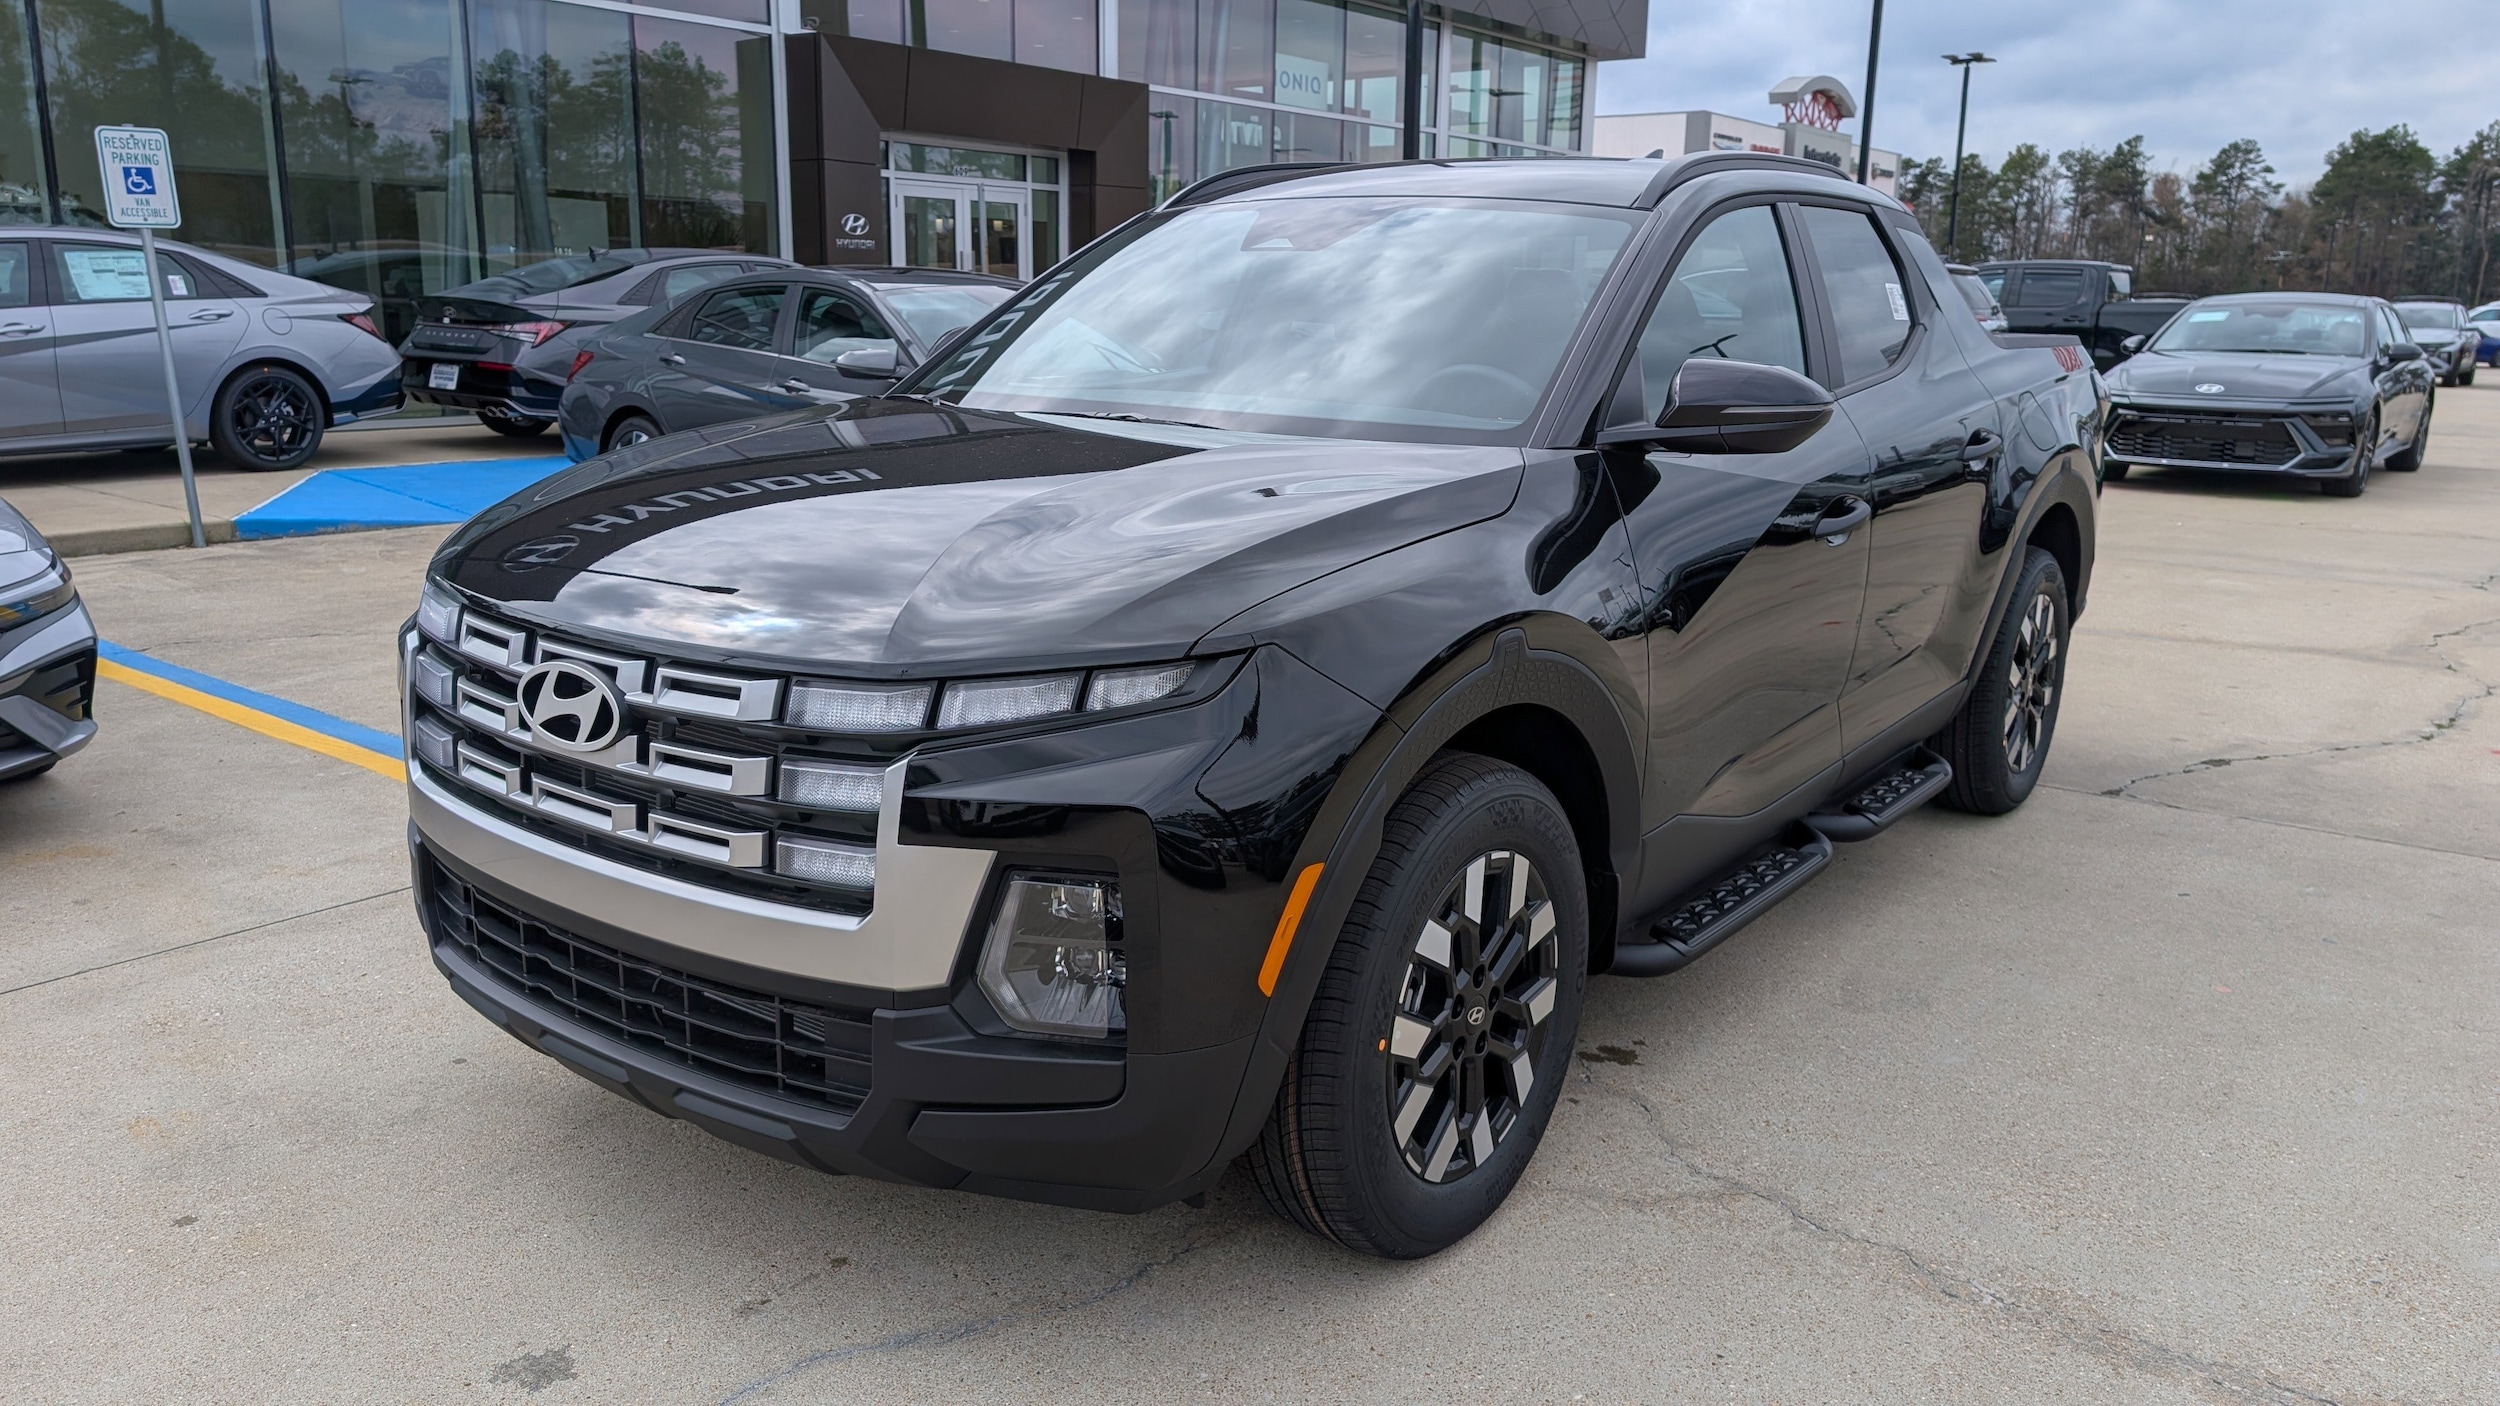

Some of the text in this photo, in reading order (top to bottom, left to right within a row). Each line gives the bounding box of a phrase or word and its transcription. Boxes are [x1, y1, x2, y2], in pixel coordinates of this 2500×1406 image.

[1279, 70, 1321, 95] ONIQ
[103, 136, 162, 151] RESERVED
[111, 152, 160, 166] PARKING
[135, 197, 151, 207] VAN
[121, 207, 168, 218] ACCESSIBLE
[835, 238, 876, 250] HYUNDAI
